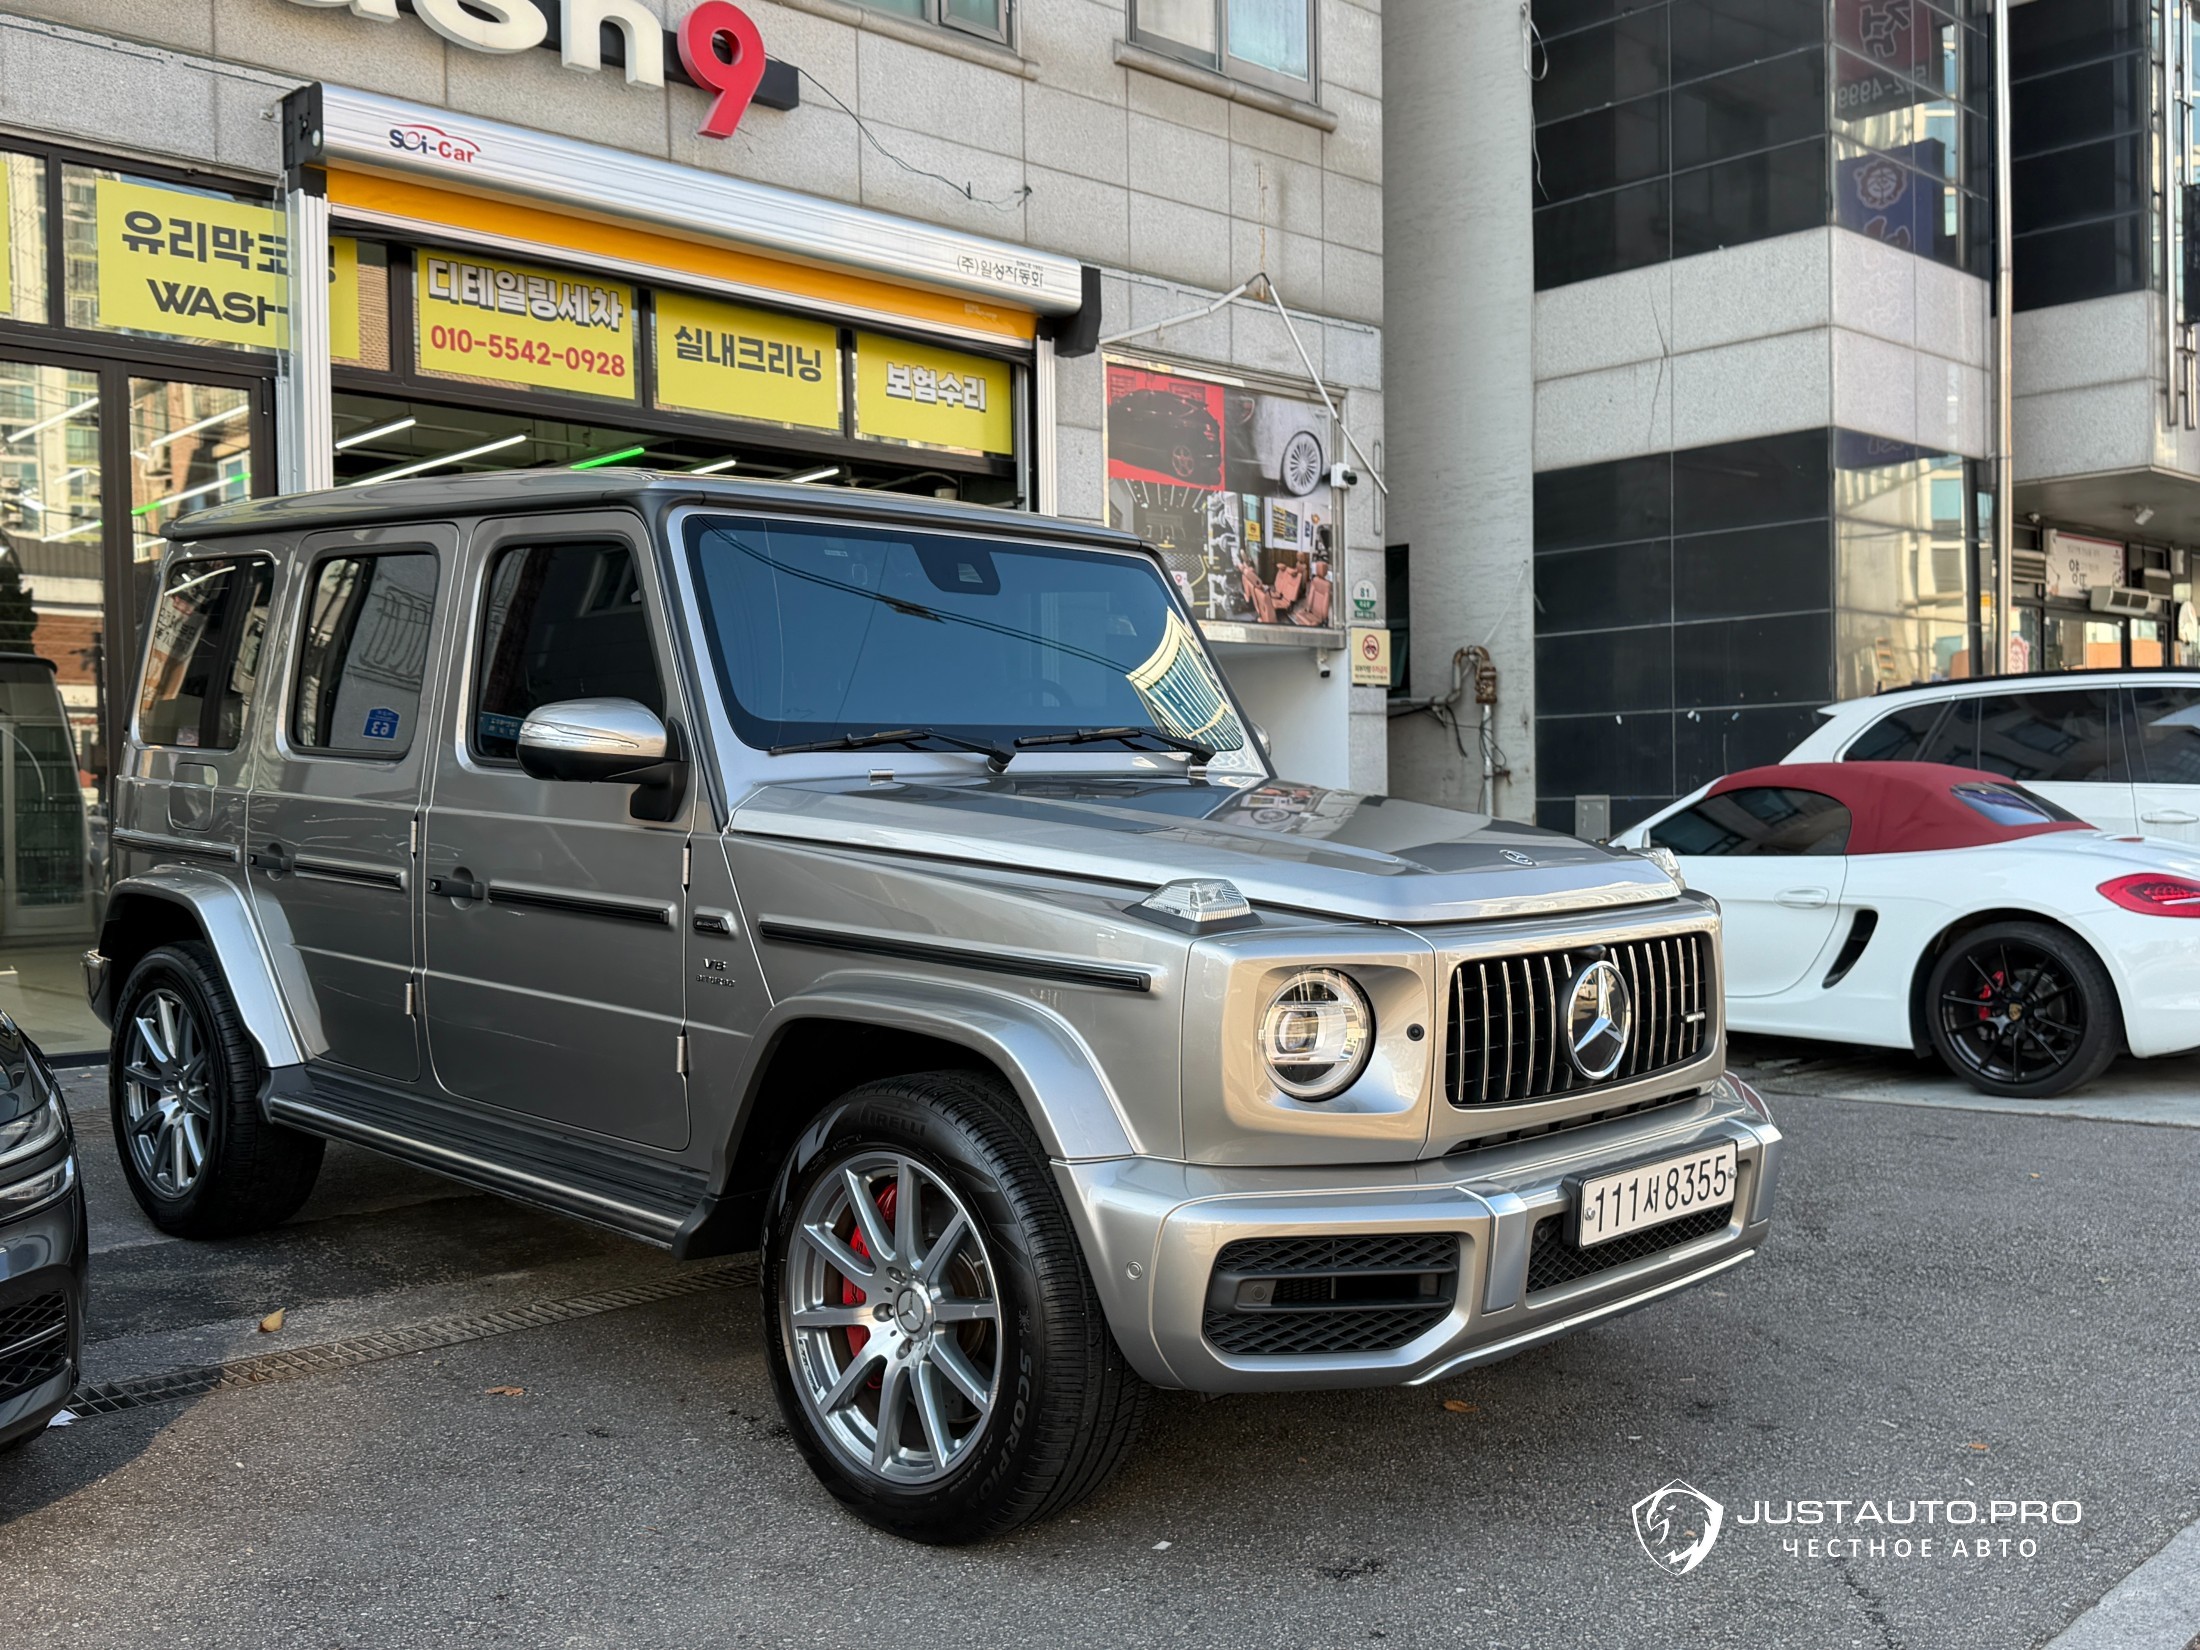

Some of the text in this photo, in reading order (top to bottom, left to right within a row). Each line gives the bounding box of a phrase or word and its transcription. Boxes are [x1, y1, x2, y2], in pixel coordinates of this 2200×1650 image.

[122, 210, 336, 284] 유리막코
[957, 254, 1044, 287] (주)일성자동화
[427, 257, 624, 333] 디테일링세차
[431, 325, 626, 378] 010-5542-0928
[674, 325, 823, 383] 실내크리닝
[885, 361, 988, 413] 보험수리
[704, 958, 727, 971] V8
